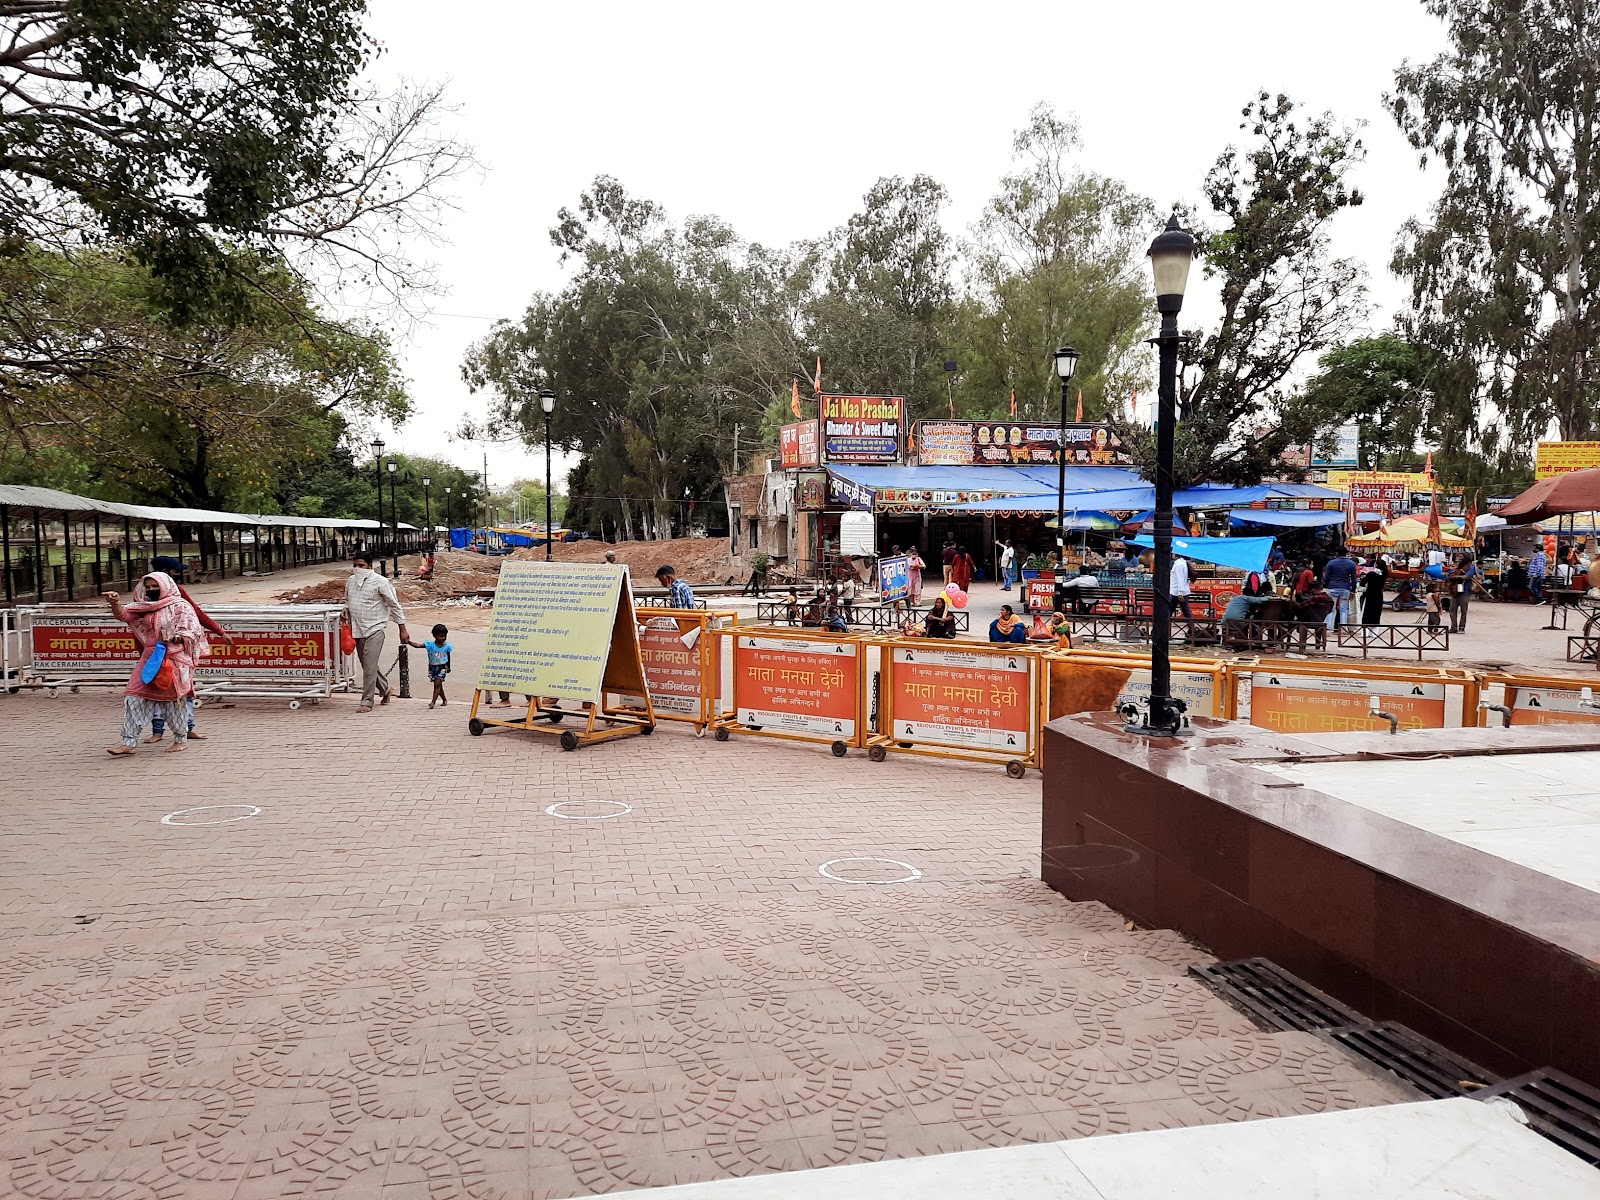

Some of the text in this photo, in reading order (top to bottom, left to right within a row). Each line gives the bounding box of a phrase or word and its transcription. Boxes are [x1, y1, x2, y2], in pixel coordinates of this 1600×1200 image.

[824, 398, 899, 419] Jai Maa Prashad
[826, 421, 897, 436] Bhandar & Sweet Mart
[1027, 428, 1044, 441] माता
[1041, 596, 1054, 607] COR
[49, 639, 136, 650] माता मनस
[209, 640, 319, 656] ाता मनसा देवी
[655, 650, 689, 664] मनसा
[747, 666, 845, 690] माता मनसा देवी
[762, 686, 773, 694] पूजा
[809, 689, 821, 698] सभी
[904, 682, 1018, 708] माता मनसा देवी
[1308, 696, 1327, 705] अपनी
[1331, 698, 1350, 708] सुरक्षा
[1354, 698, 1361, 707] के
[922, 703, 934, 712] पूजा
[936, 704, 950, 712] स्थल
[977, 707, 990, 716] सभी
[1266, 710, 1376, 731] माता मनसा
[971, 727, 1004, 735] PROMOTIONS
